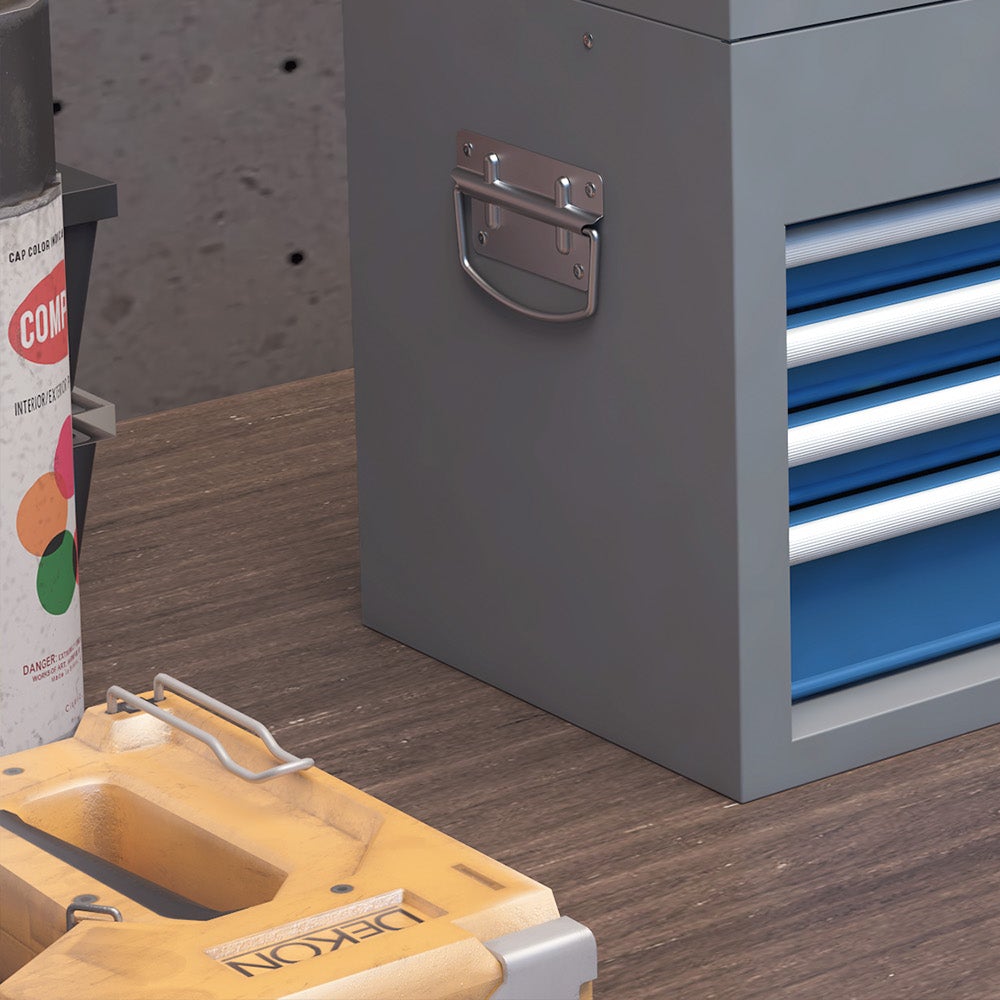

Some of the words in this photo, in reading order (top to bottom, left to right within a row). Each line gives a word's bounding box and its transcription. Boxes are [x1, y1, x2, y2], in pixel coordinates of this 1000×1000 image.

[8, 249, 26, 263] CAP
[27, 239, 51, 257] COLOR
[225, 907, 425, 978] DEKON
